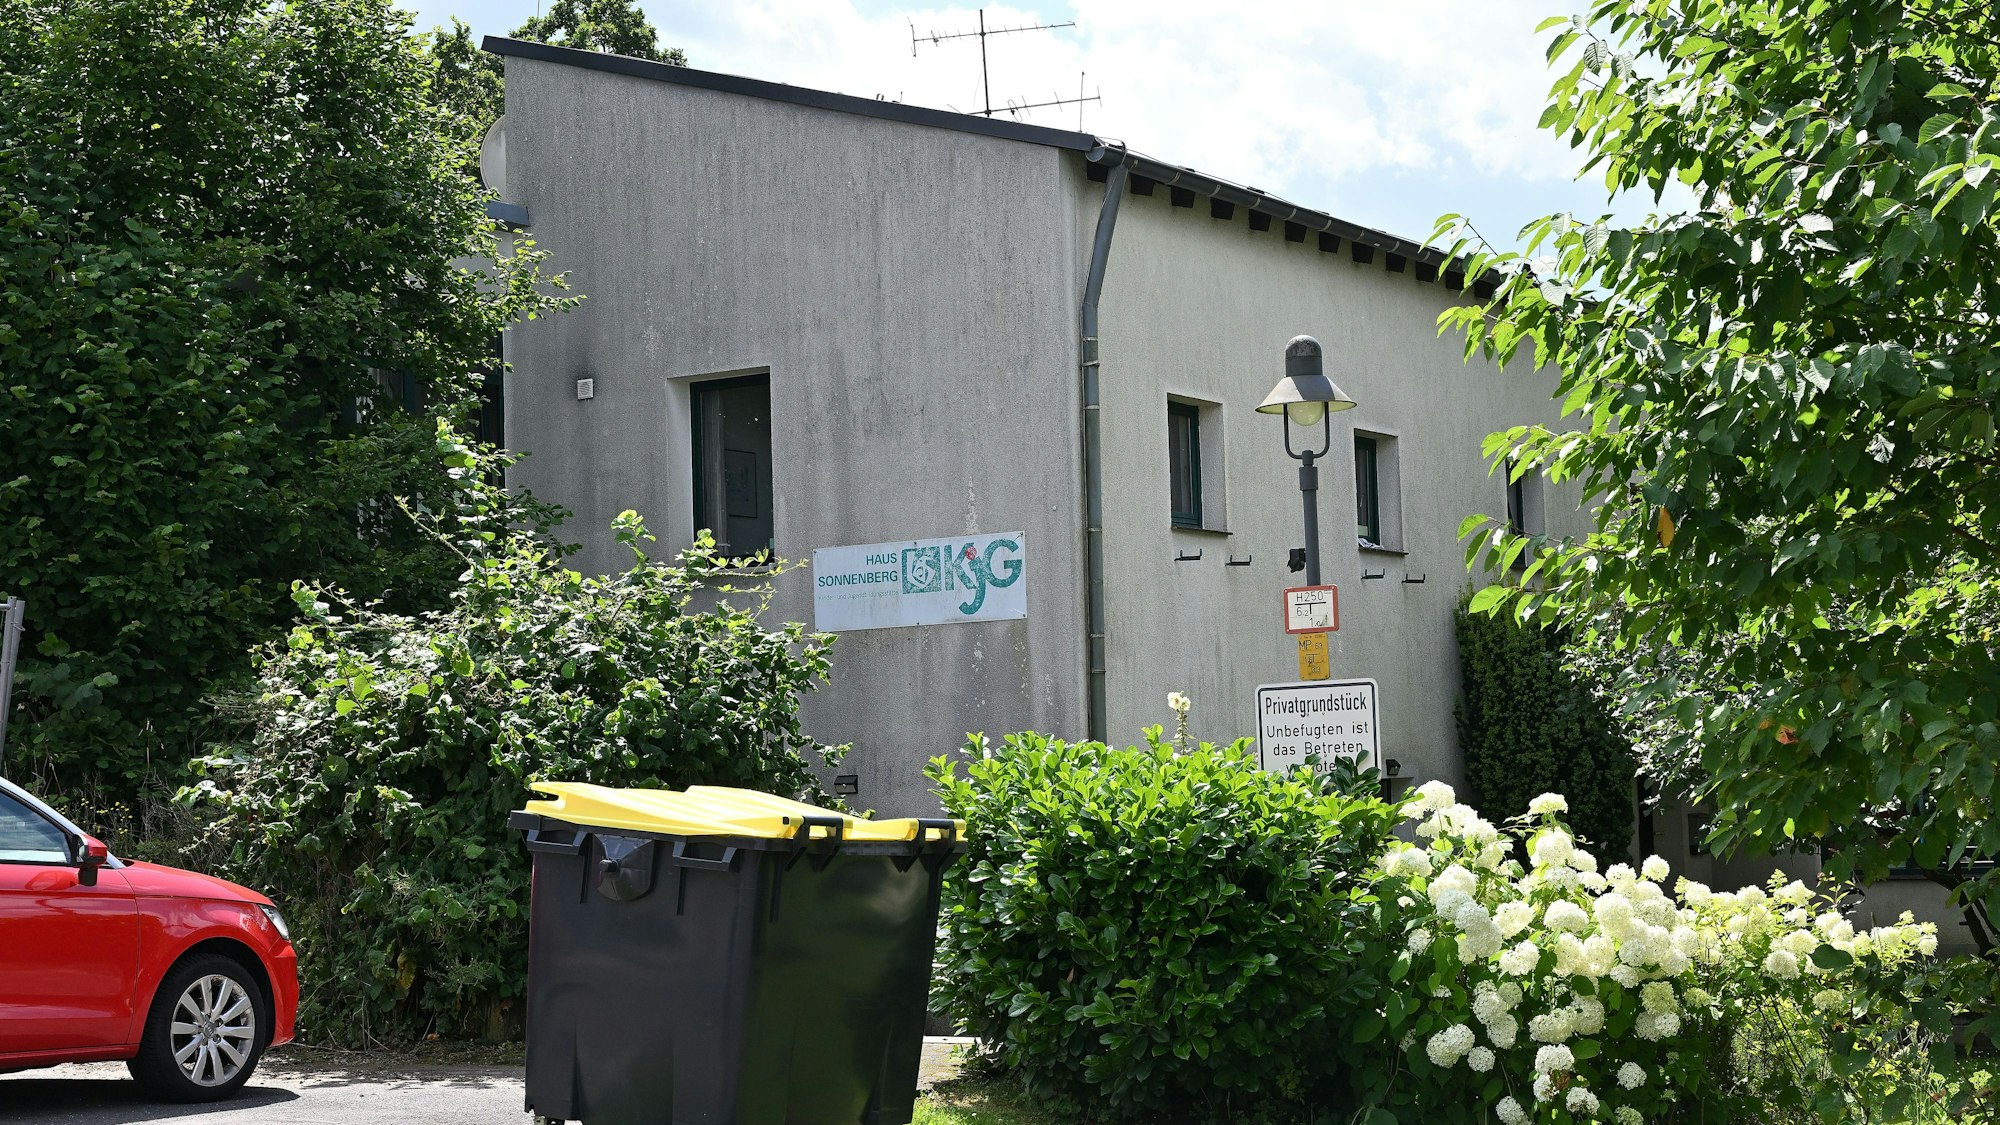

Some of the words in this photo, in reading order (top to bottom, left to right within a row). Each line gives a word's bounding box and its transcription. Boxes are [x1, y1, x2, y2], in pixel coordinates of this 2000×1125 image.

[866, 552, 898, 566] HAUS
[818, 570, 898, 588] SONNENBERG
[1296, 590, 1324, 603] H250
[1265, 691, 1368, 718] Privatgrundstück
[1266, 723, 1343, 740] Unbefugten
[1352, 721, 1369, 734] ist
[1273, 743, 1296, 756] das
[1304, 740, 1364, 755] Betreten
